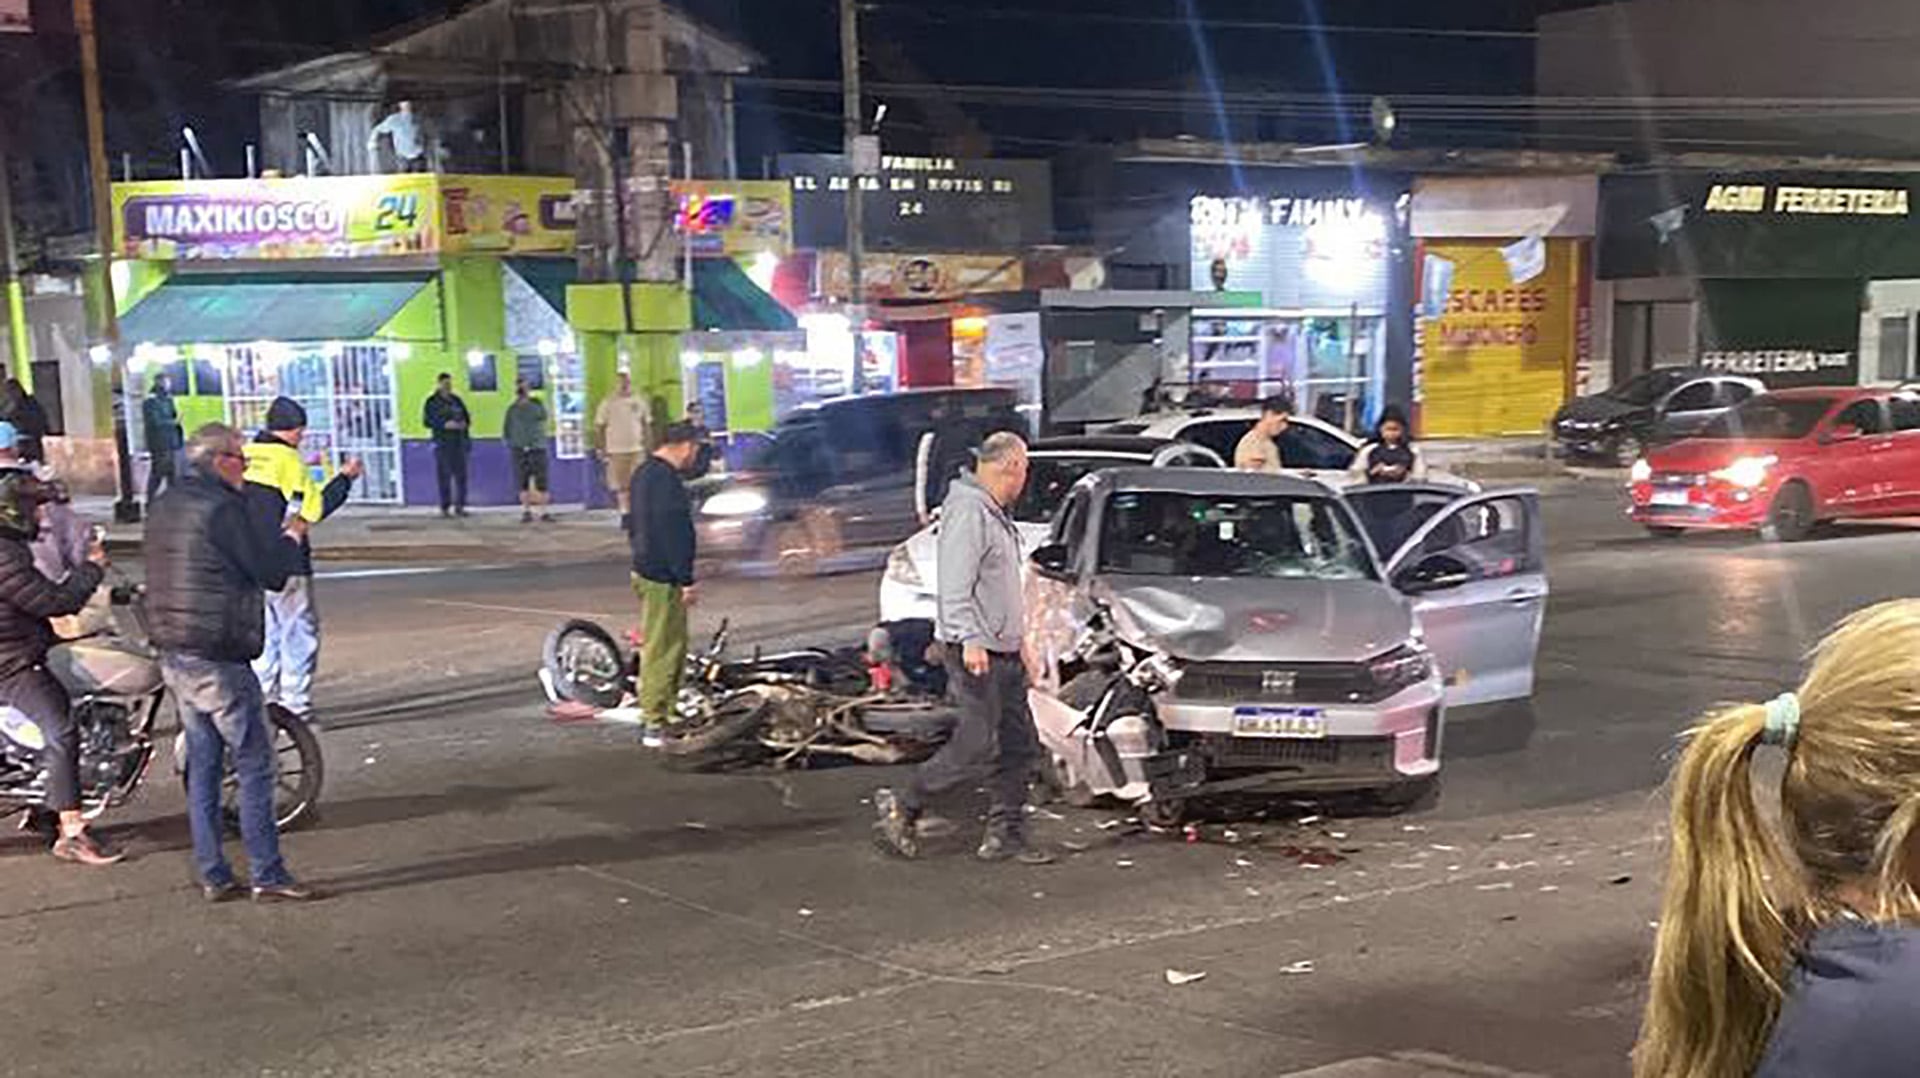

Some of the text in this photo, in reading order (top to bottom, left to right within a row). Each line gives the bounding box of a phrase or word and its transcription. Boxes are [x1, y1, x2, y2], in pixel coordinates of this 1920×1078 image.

[881, 156, 954, 170] FAMILIA
[375, 195, 417, 231] 24
[1774, 186, 1909, 214] FERRETERIA
[145, 203, 337, 235] MAXIKIOSCO
[1700, 351, 1818, 373] FERRETERIA
